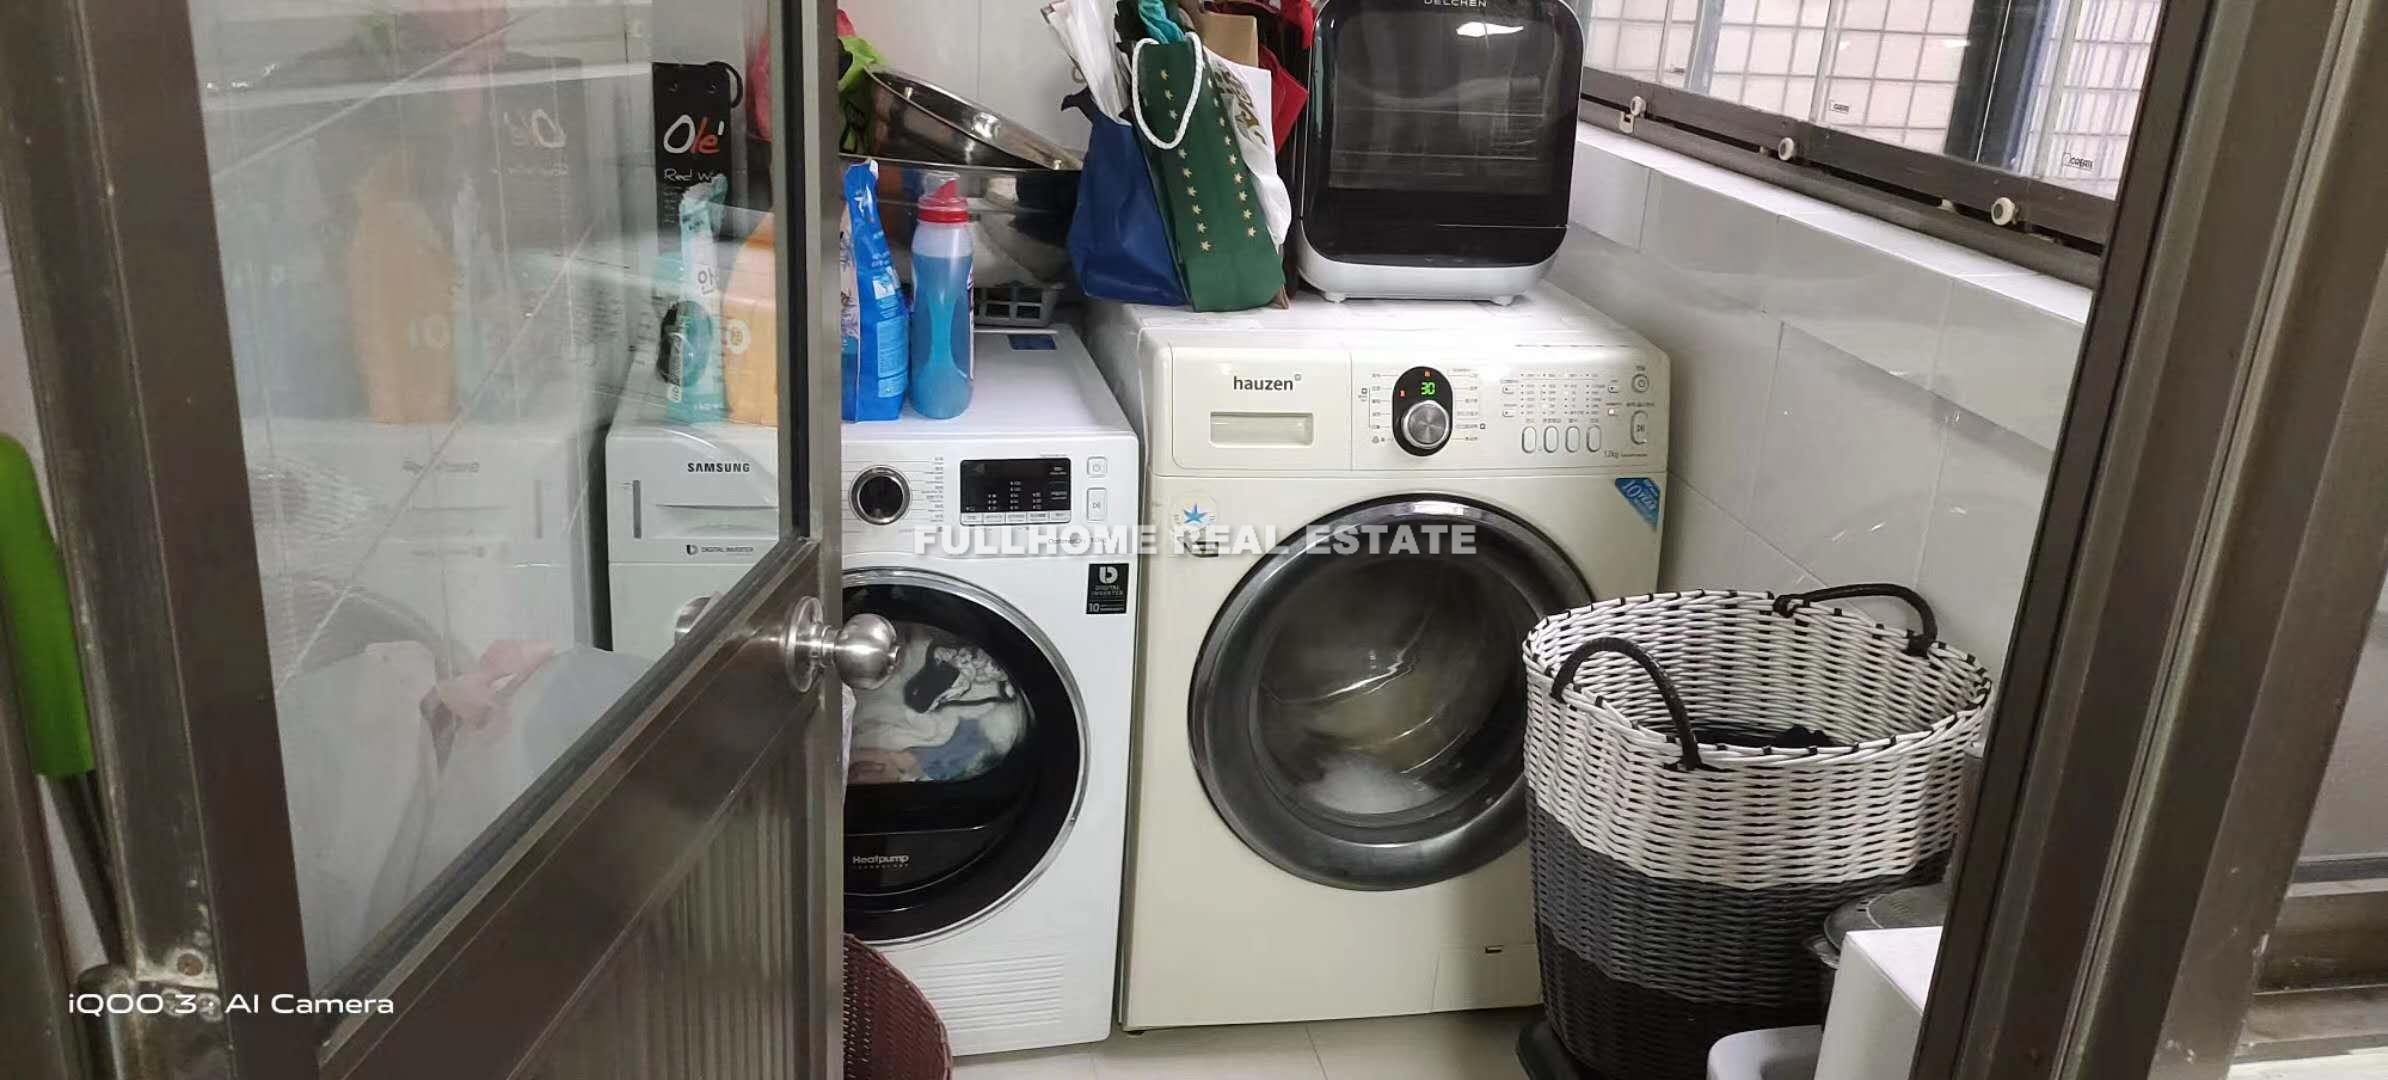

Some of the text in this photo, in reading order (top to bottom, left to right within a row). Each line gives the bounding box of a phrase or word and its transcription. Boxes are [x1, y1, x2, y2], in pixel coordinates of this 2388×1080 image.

[1233, 376, 1294, 391] hauzen
[1421, 382, 1436, 395] 30
[687, 463, 751, 473] SAMSUNG
